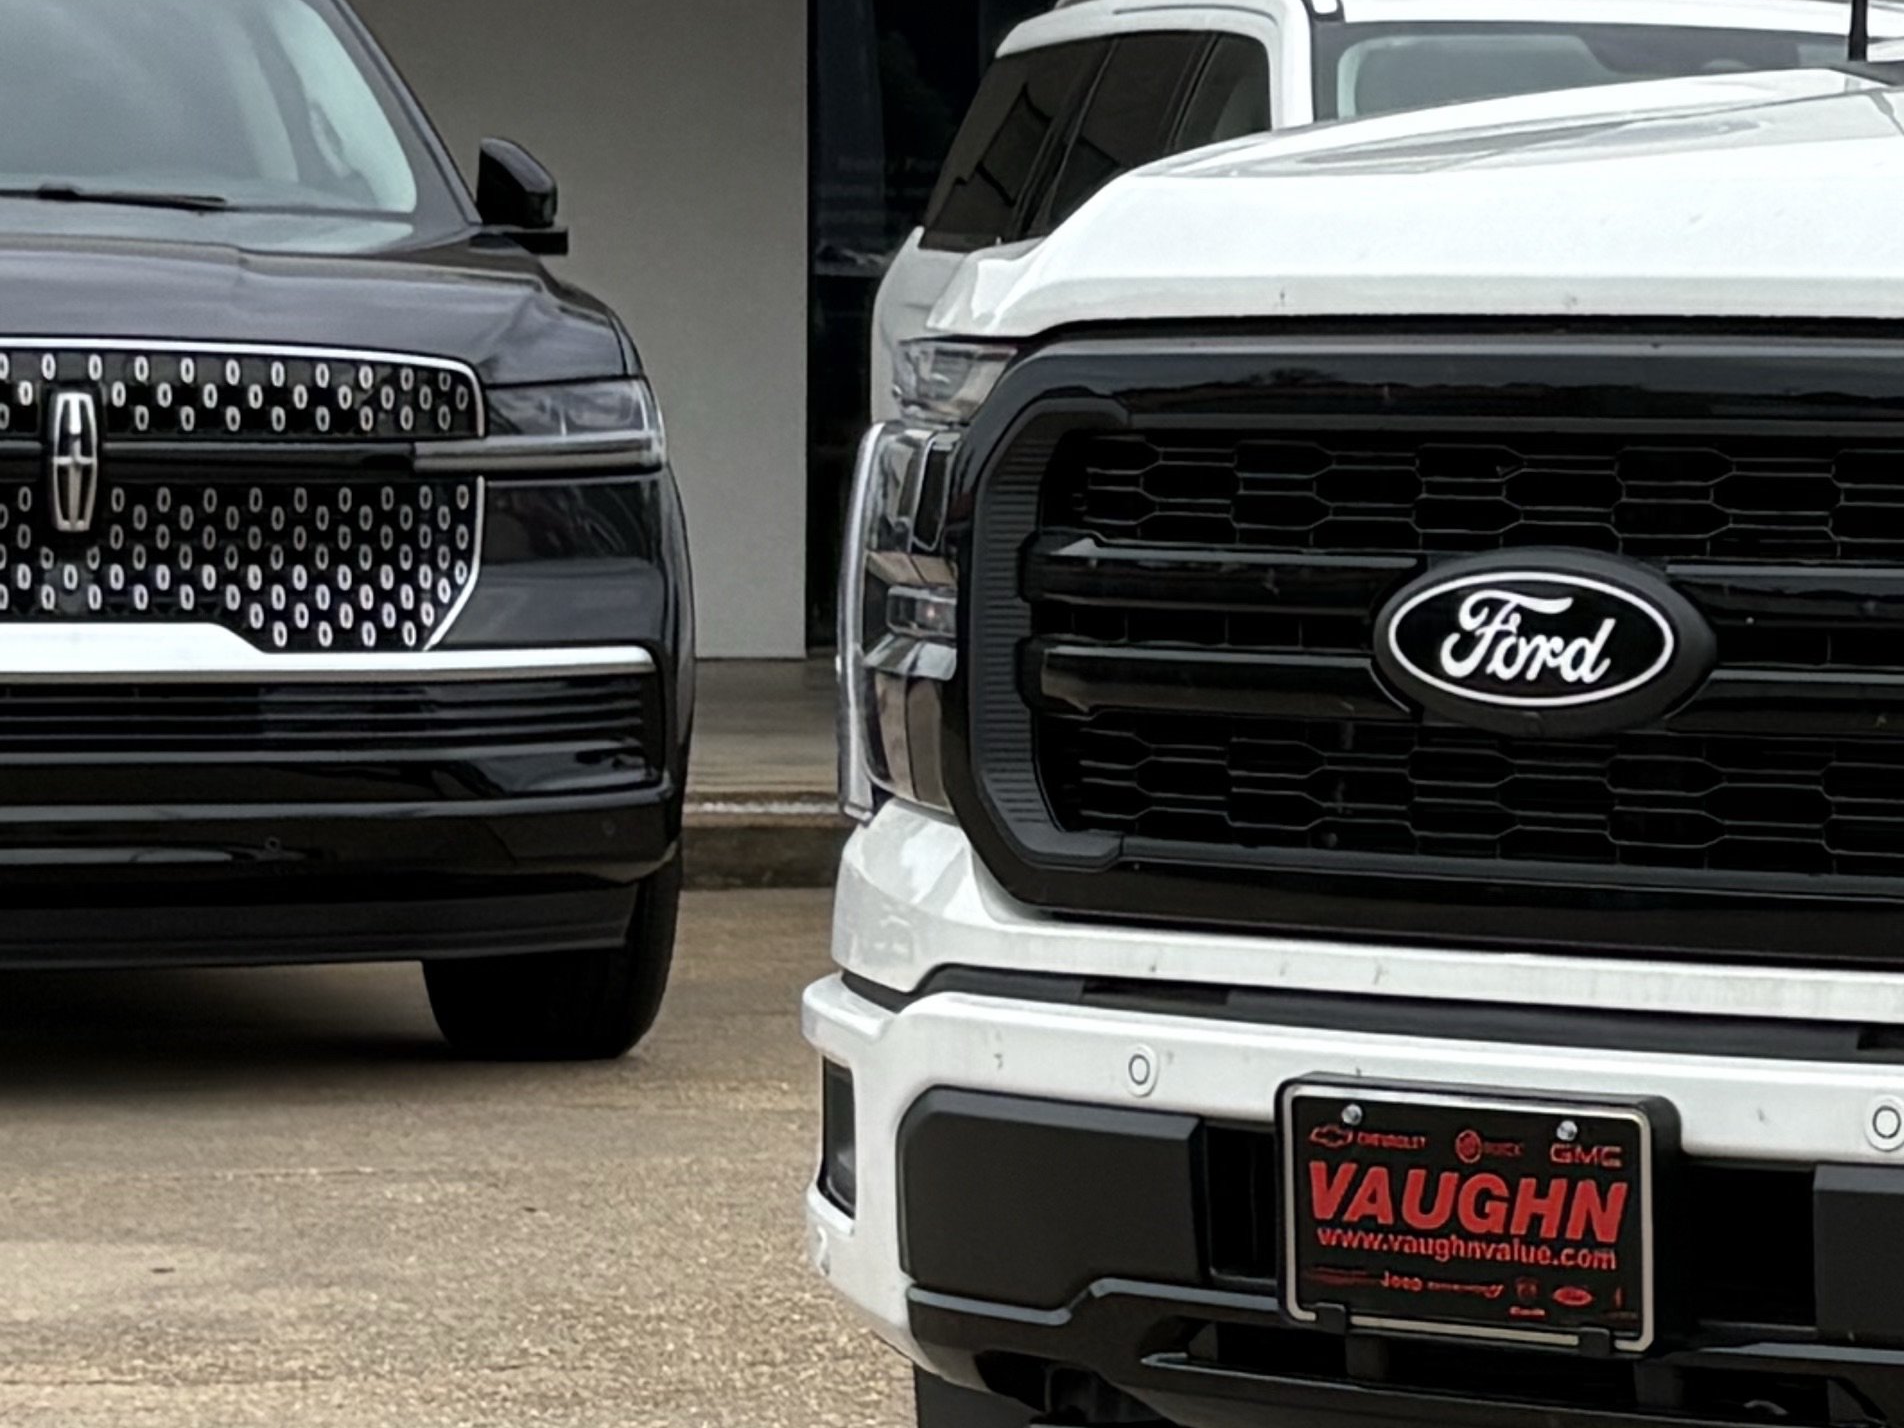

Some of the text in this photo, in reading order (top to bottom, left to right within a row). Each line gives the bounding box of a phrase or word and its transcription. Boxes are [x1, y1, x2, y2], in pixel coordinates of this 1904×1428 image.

[1440, 589, 1616, 684] Ford
[1549, 1142, 1623, 1168] GMC
[1308, 1160, 1629, 1243] VAUGHN
[1316, 1227, 1617, 1270] www.vaughnvalue.com
